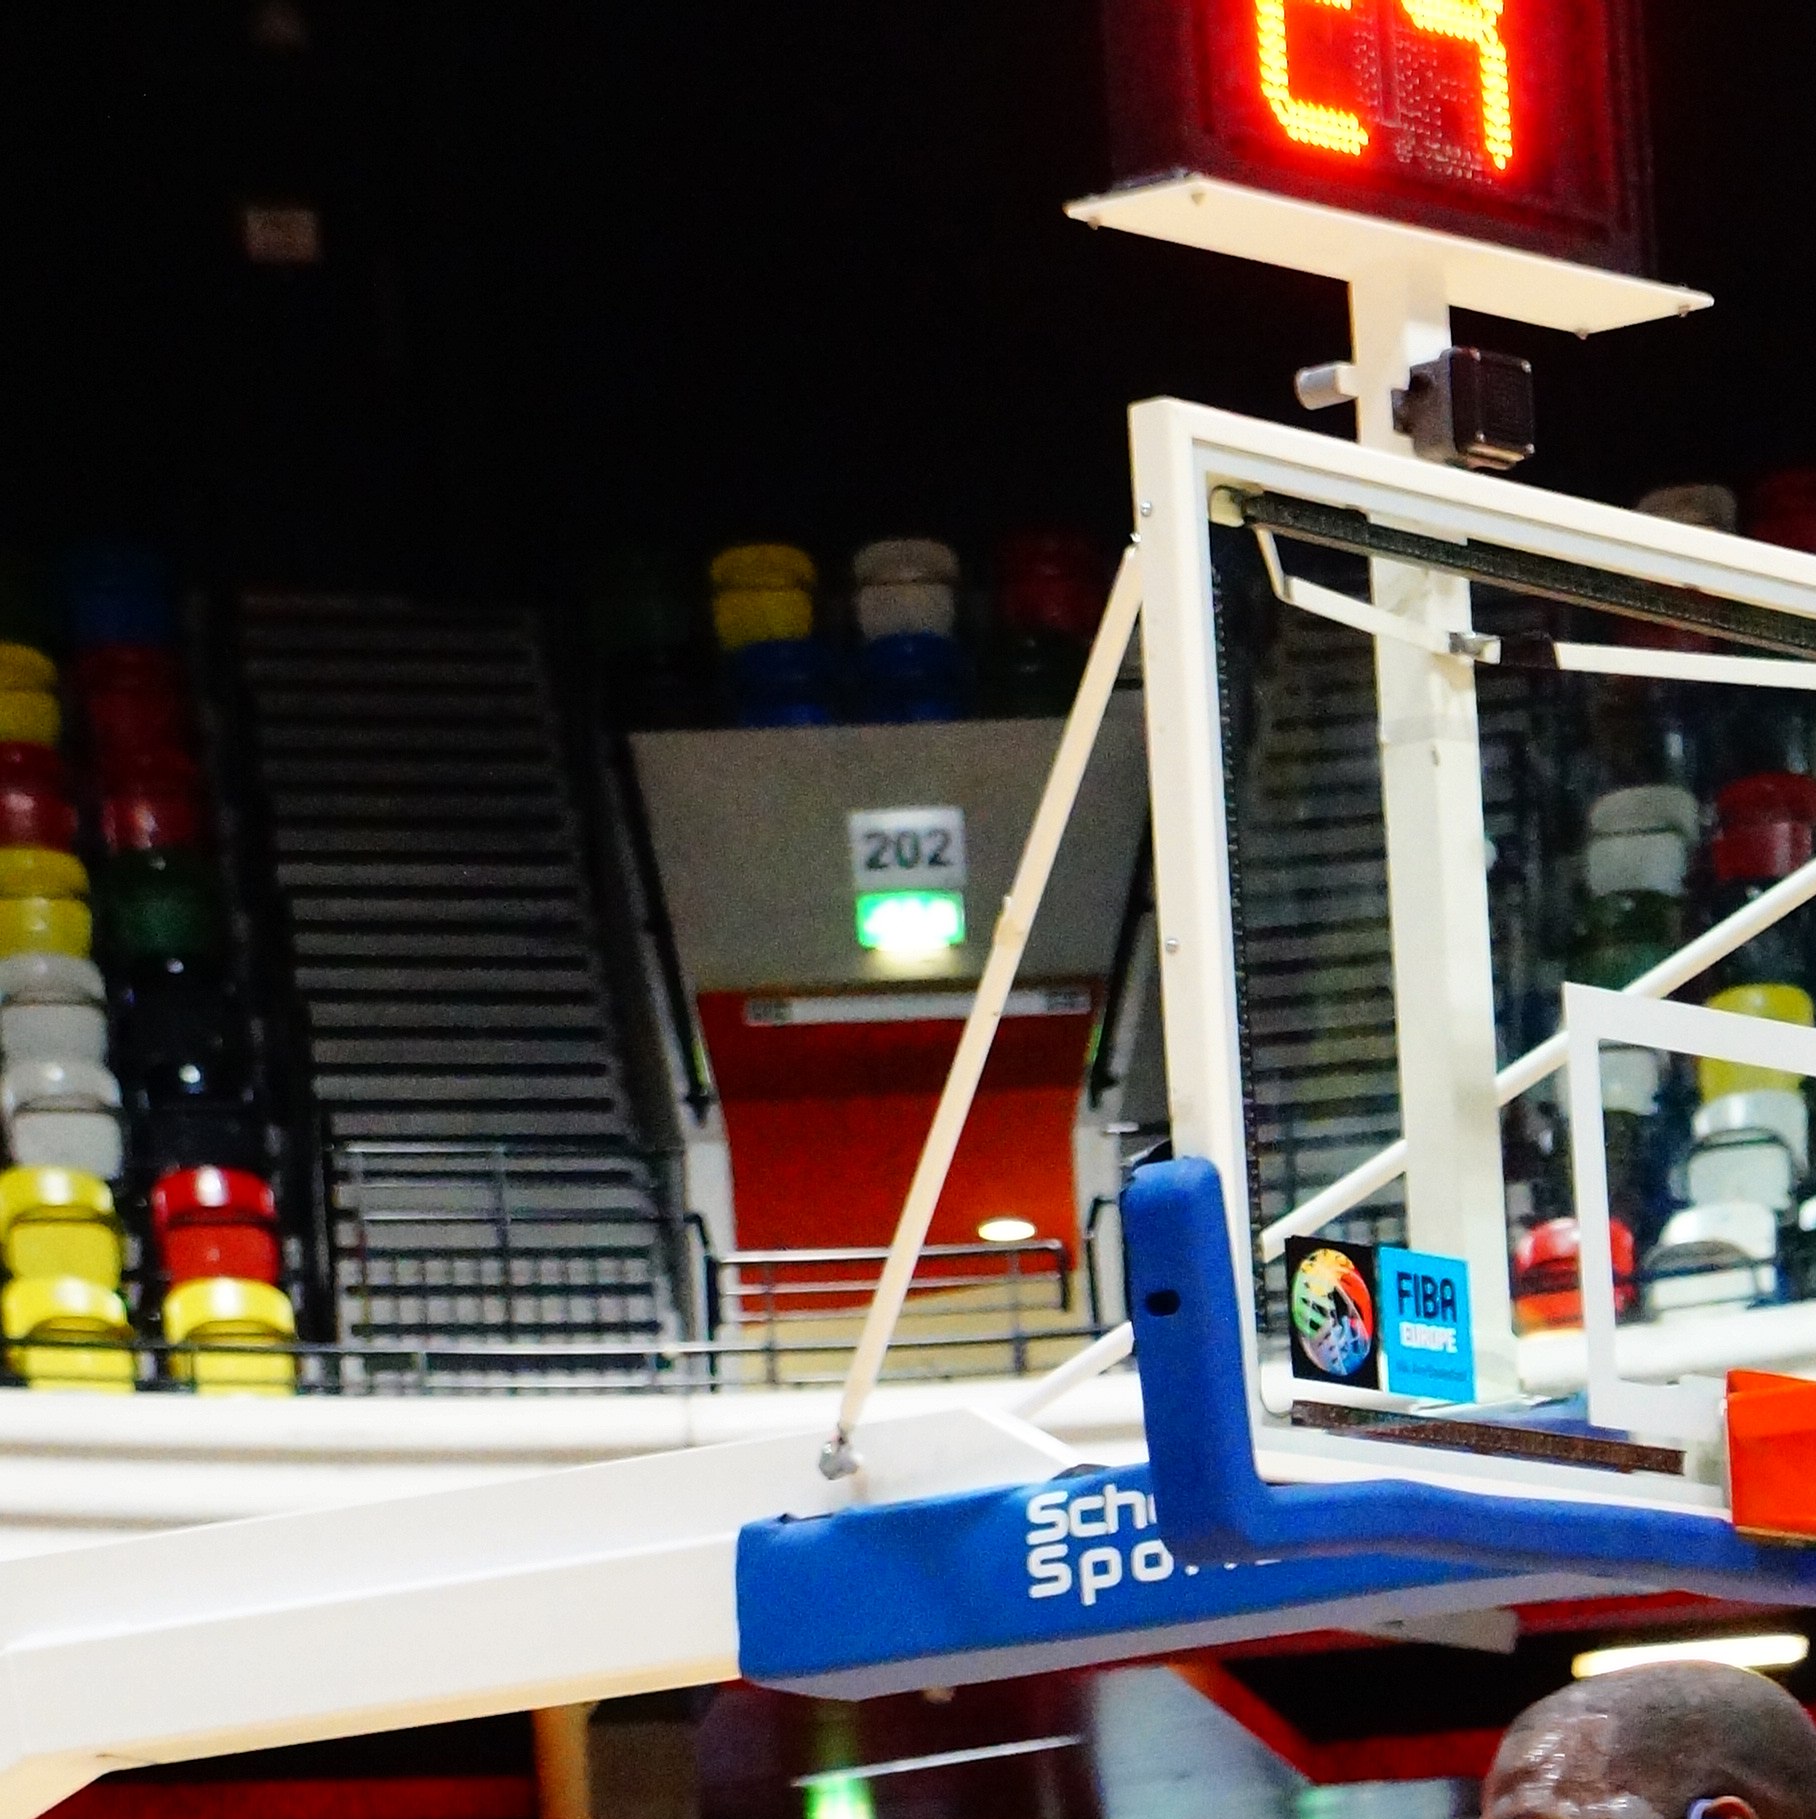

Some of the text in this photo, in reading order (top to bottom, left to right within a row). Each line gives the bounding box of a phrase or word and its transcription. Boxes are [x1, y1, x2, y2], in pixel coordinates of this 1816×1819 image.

[863, 830, 954, 871] 202
[1396, 1270, 1458, 1323] FIBA
[1399, 1321, 1459, 1354] EUROPE
[1026, 1483, 1158, 1546] Sch
